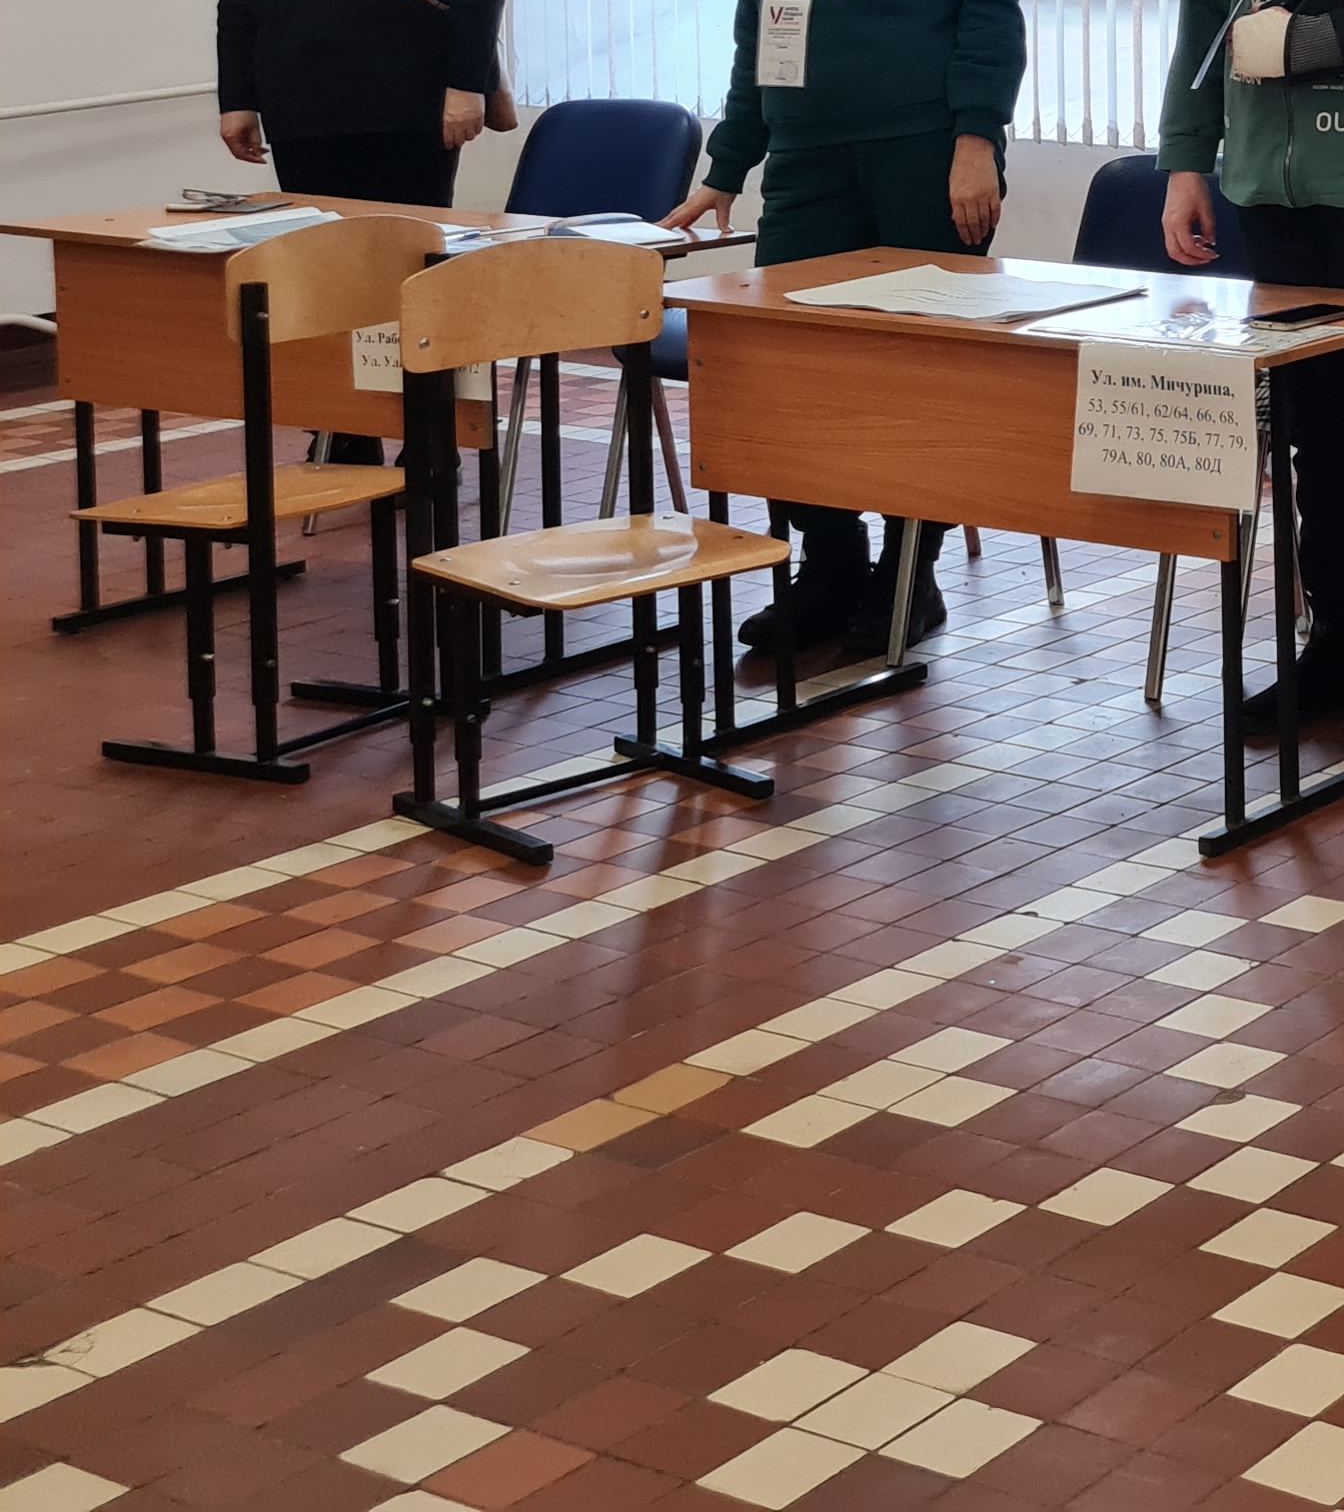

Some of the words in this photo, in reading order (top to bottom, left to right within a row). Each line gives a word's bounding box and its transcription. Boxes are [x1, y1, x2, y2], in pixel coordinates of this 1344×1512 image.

[378, 332, 400, 344] Раб
[1091, 369, 1117, 386] Ул.
[1121, 376, 1146, 389] им.
[1150, 374, 1236, 399] Мичурина,
[1088, 398, 1107, 414] 53,
[1111, 400, 1150, 418] 55/61,
[1153, 403, 1193, 421] 62/64,
[1196, 408, 1216, 424] 66,
[1219, 410, 1239, 426] 68,
[1078, 422, 1098, 438] 69,
[1102, 424, 1121, 440] 71,
[1126, 426, 1145, 442] 73,
[1150, 428, 1168, 444] 75,
[1173, 430, 1201, 447] 75Б,
[1205, 433, 1224, 449] 77,
[1228, 435, 1248, 451] 79,
[1101, 448, 1132, 466] 79А,
[1136, 451, 1156, 469] 80,
[1160, 454, 1191, 472] 80А,
[1194, 457, 1222, 475] 80Д
